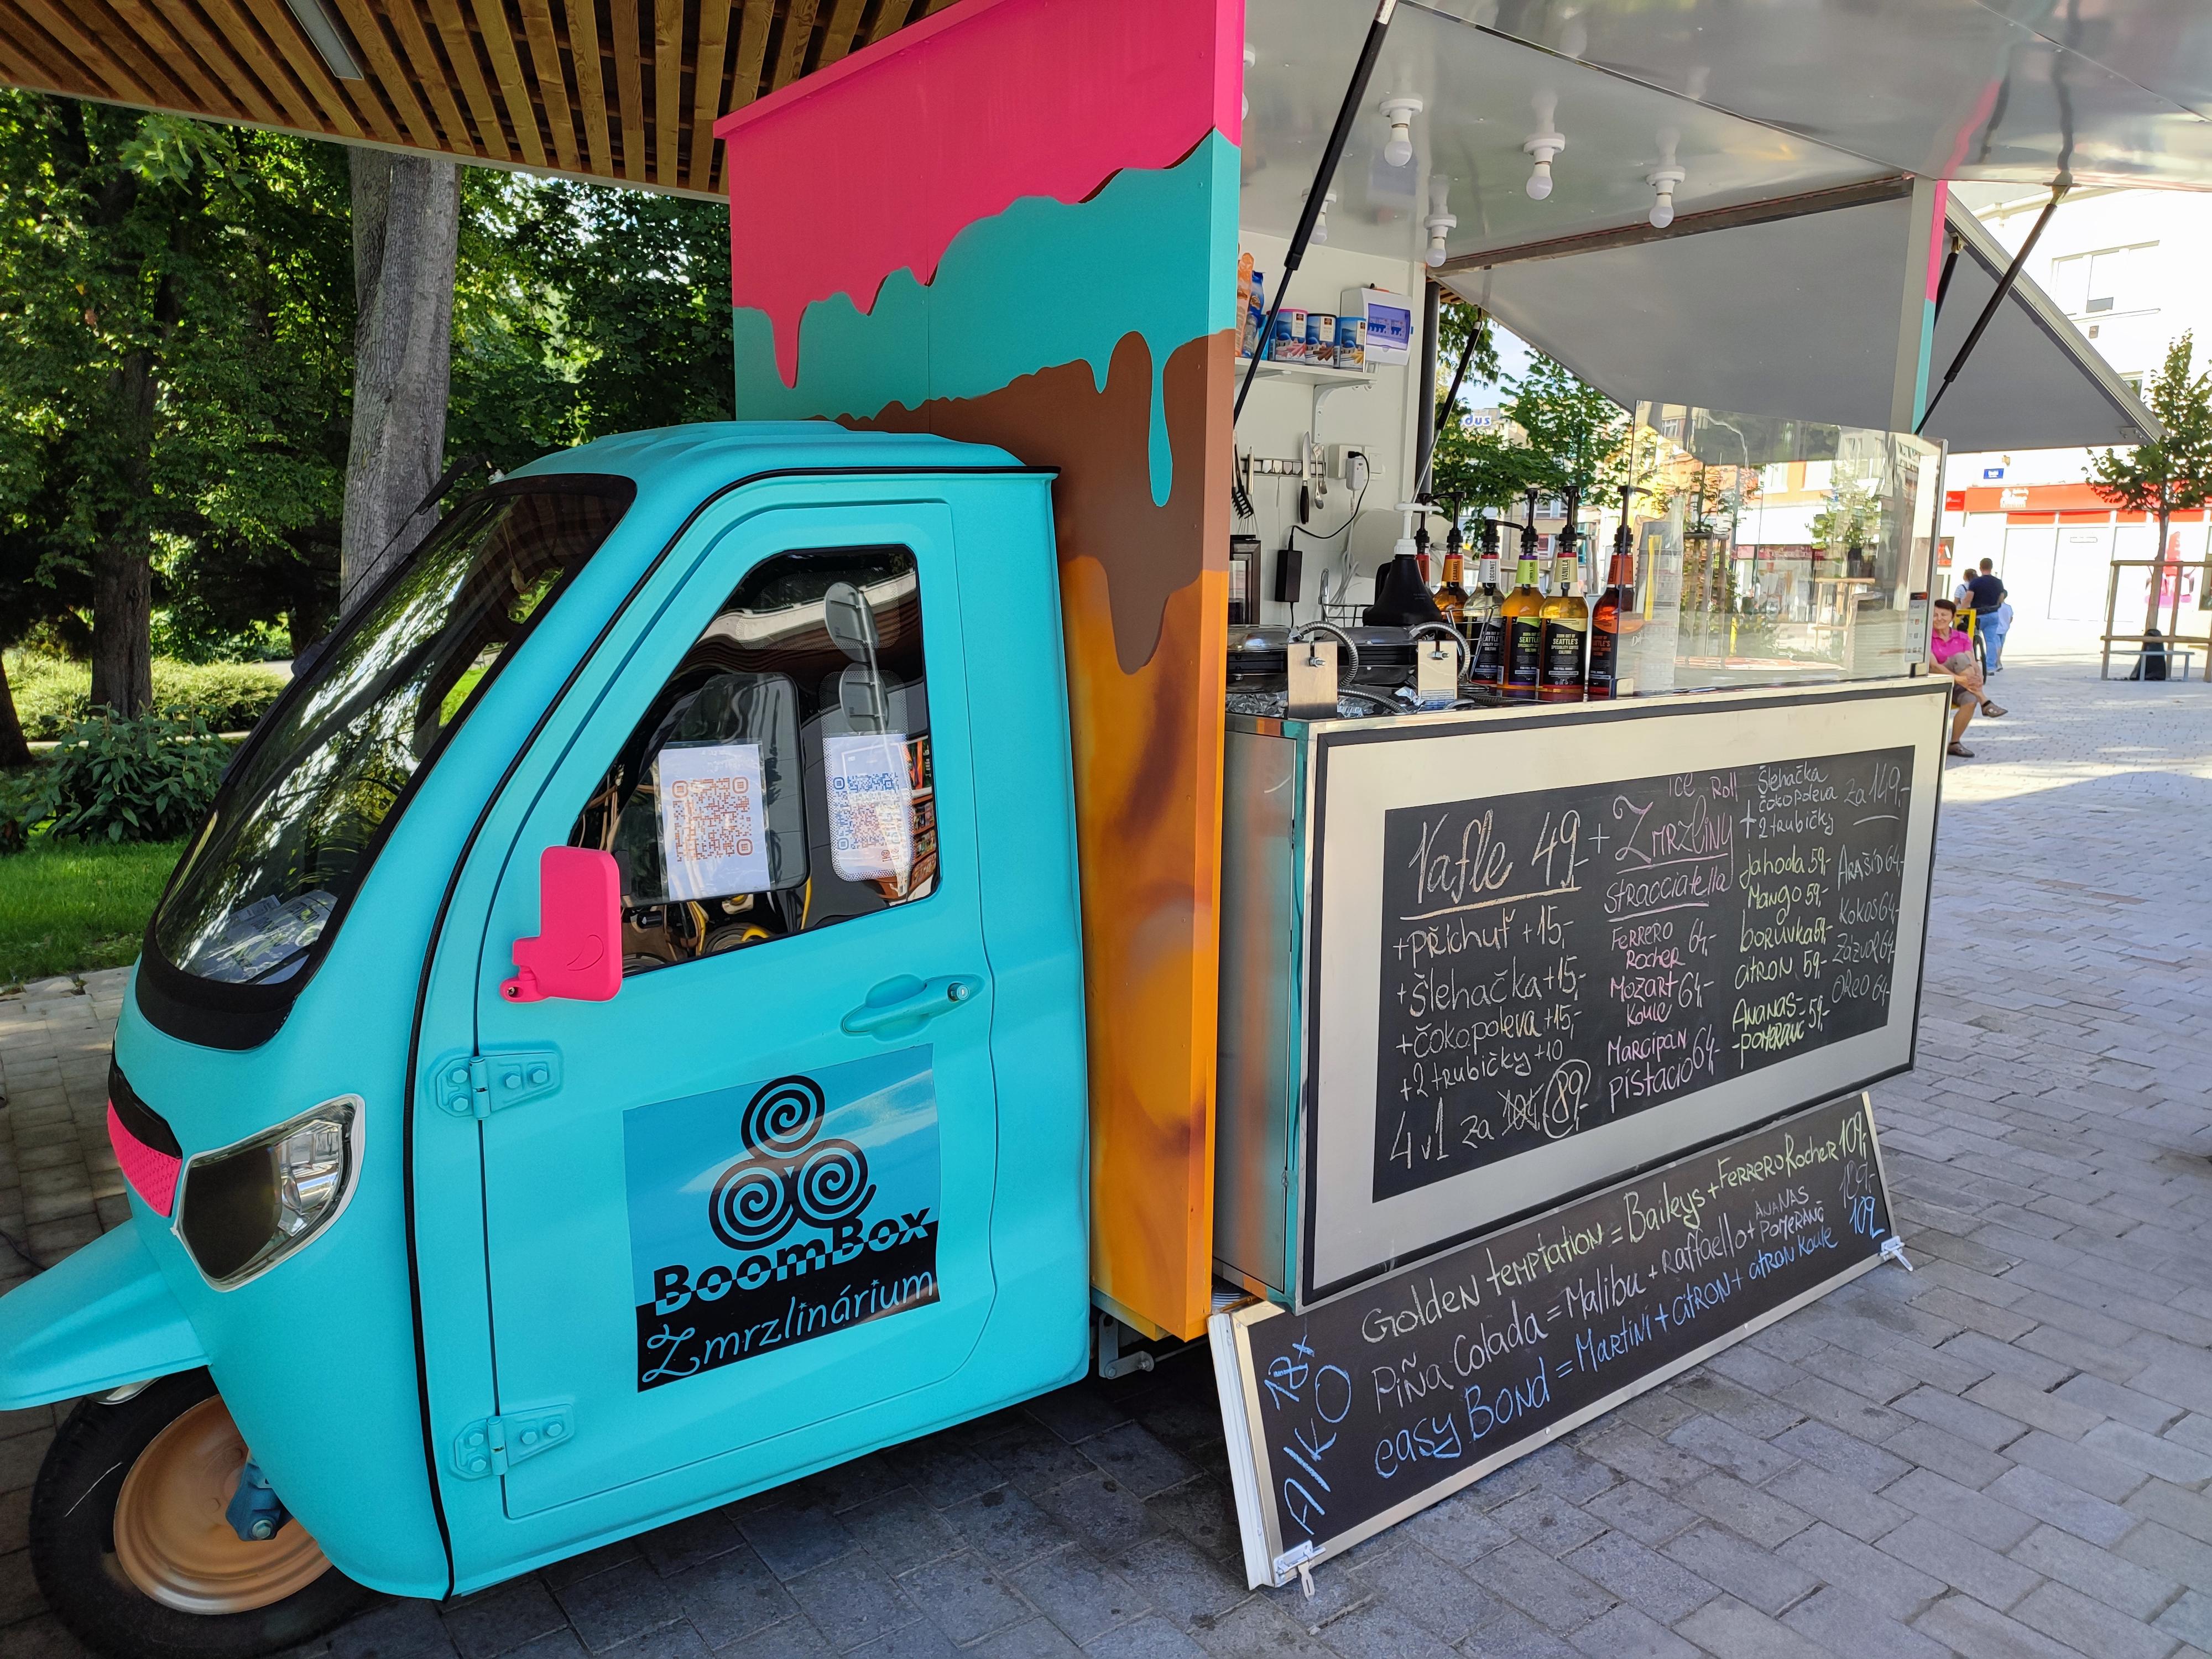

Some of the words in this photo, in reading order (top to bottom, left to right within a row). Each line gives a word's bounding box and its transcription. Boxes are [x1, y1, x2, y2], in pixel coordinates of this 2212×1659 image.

[1561, 559, 1569, 581] VANILLA
[1408, 809, 1514, 904] Vafle
[1758, 816, 1769, 839] 2
[1460, 1114, 1495, 1149] za
[653, 1206, 932, 1317] BoomBox
[641, 1270, 933, 1383] Zmrzlinárium
